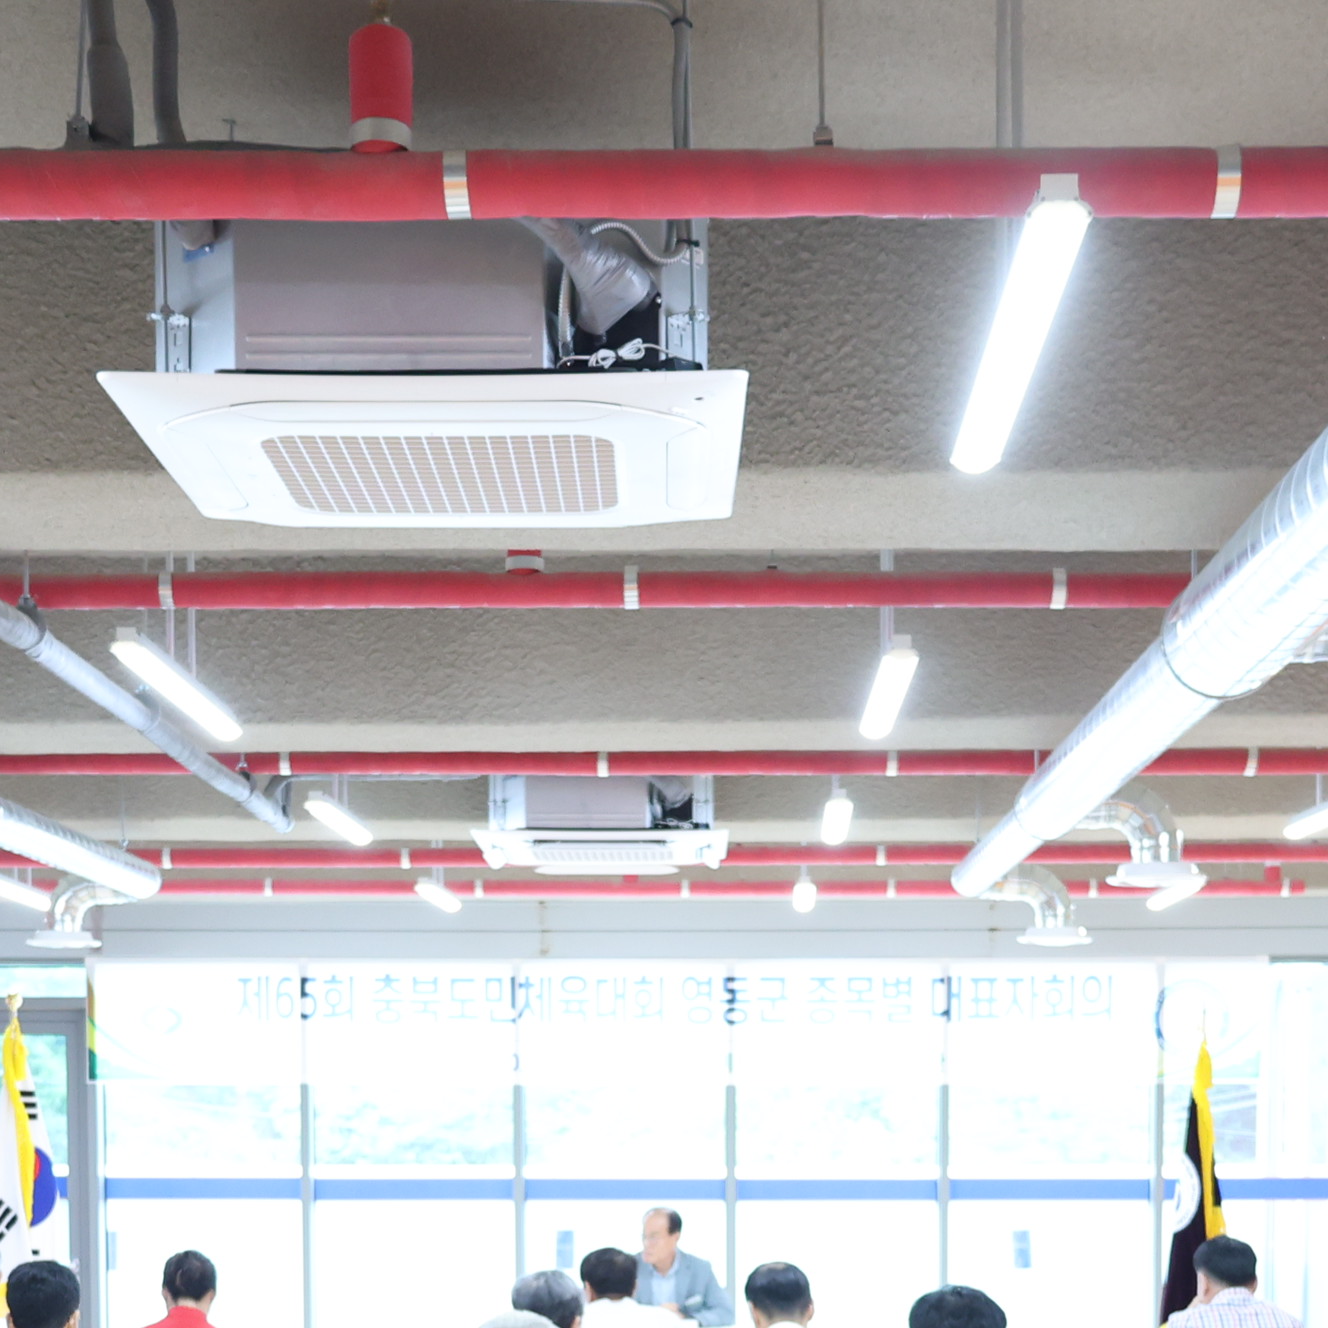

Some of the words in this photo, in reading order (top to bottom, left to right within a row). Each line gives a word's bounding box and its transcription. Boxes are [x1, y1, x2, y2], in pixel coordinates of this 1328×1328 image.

[237, 973, 356, 1022] 제65회
[372, 973, 666, 1024] 충북도민체육대회
[681, 973, 790, 1026] 영동군
[807, 973, 914, 1024] 종목별
[929, 972, 1115, 1023] 대표자회의
